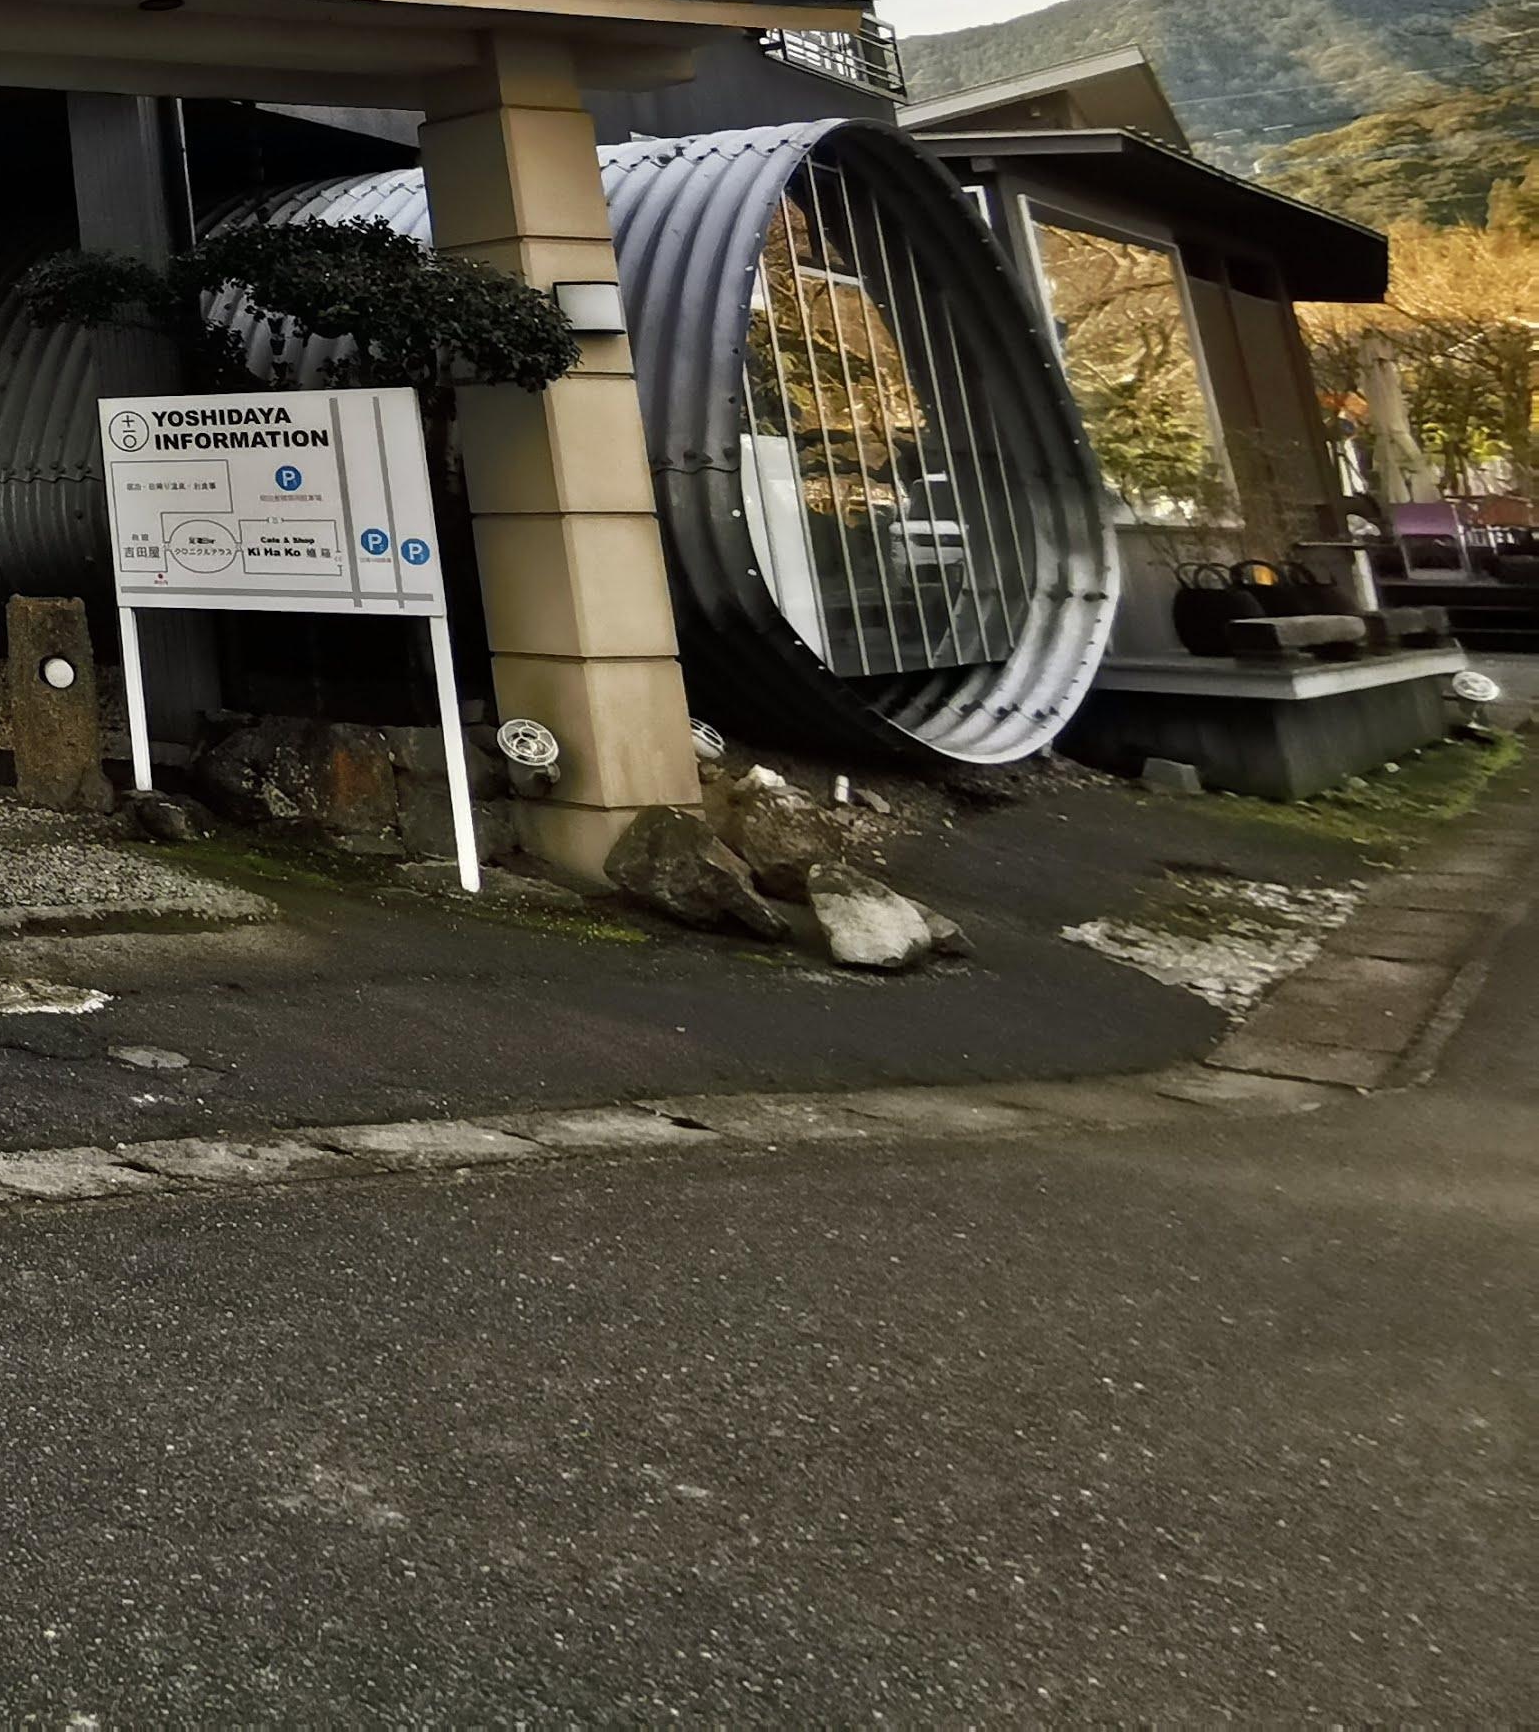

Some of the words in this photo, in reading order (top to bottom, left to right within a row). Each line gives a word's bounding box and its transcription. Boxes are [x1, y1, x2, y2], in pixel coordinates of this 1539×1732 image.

[152, 408, 292, 427] YOSHIDAYA
[155, 430, 329, 450] INFORMATION
[247, 547, 261, 557] Ki
[264, 547, 281, 557] Ha
[285, 547, 301, 557] Ko
